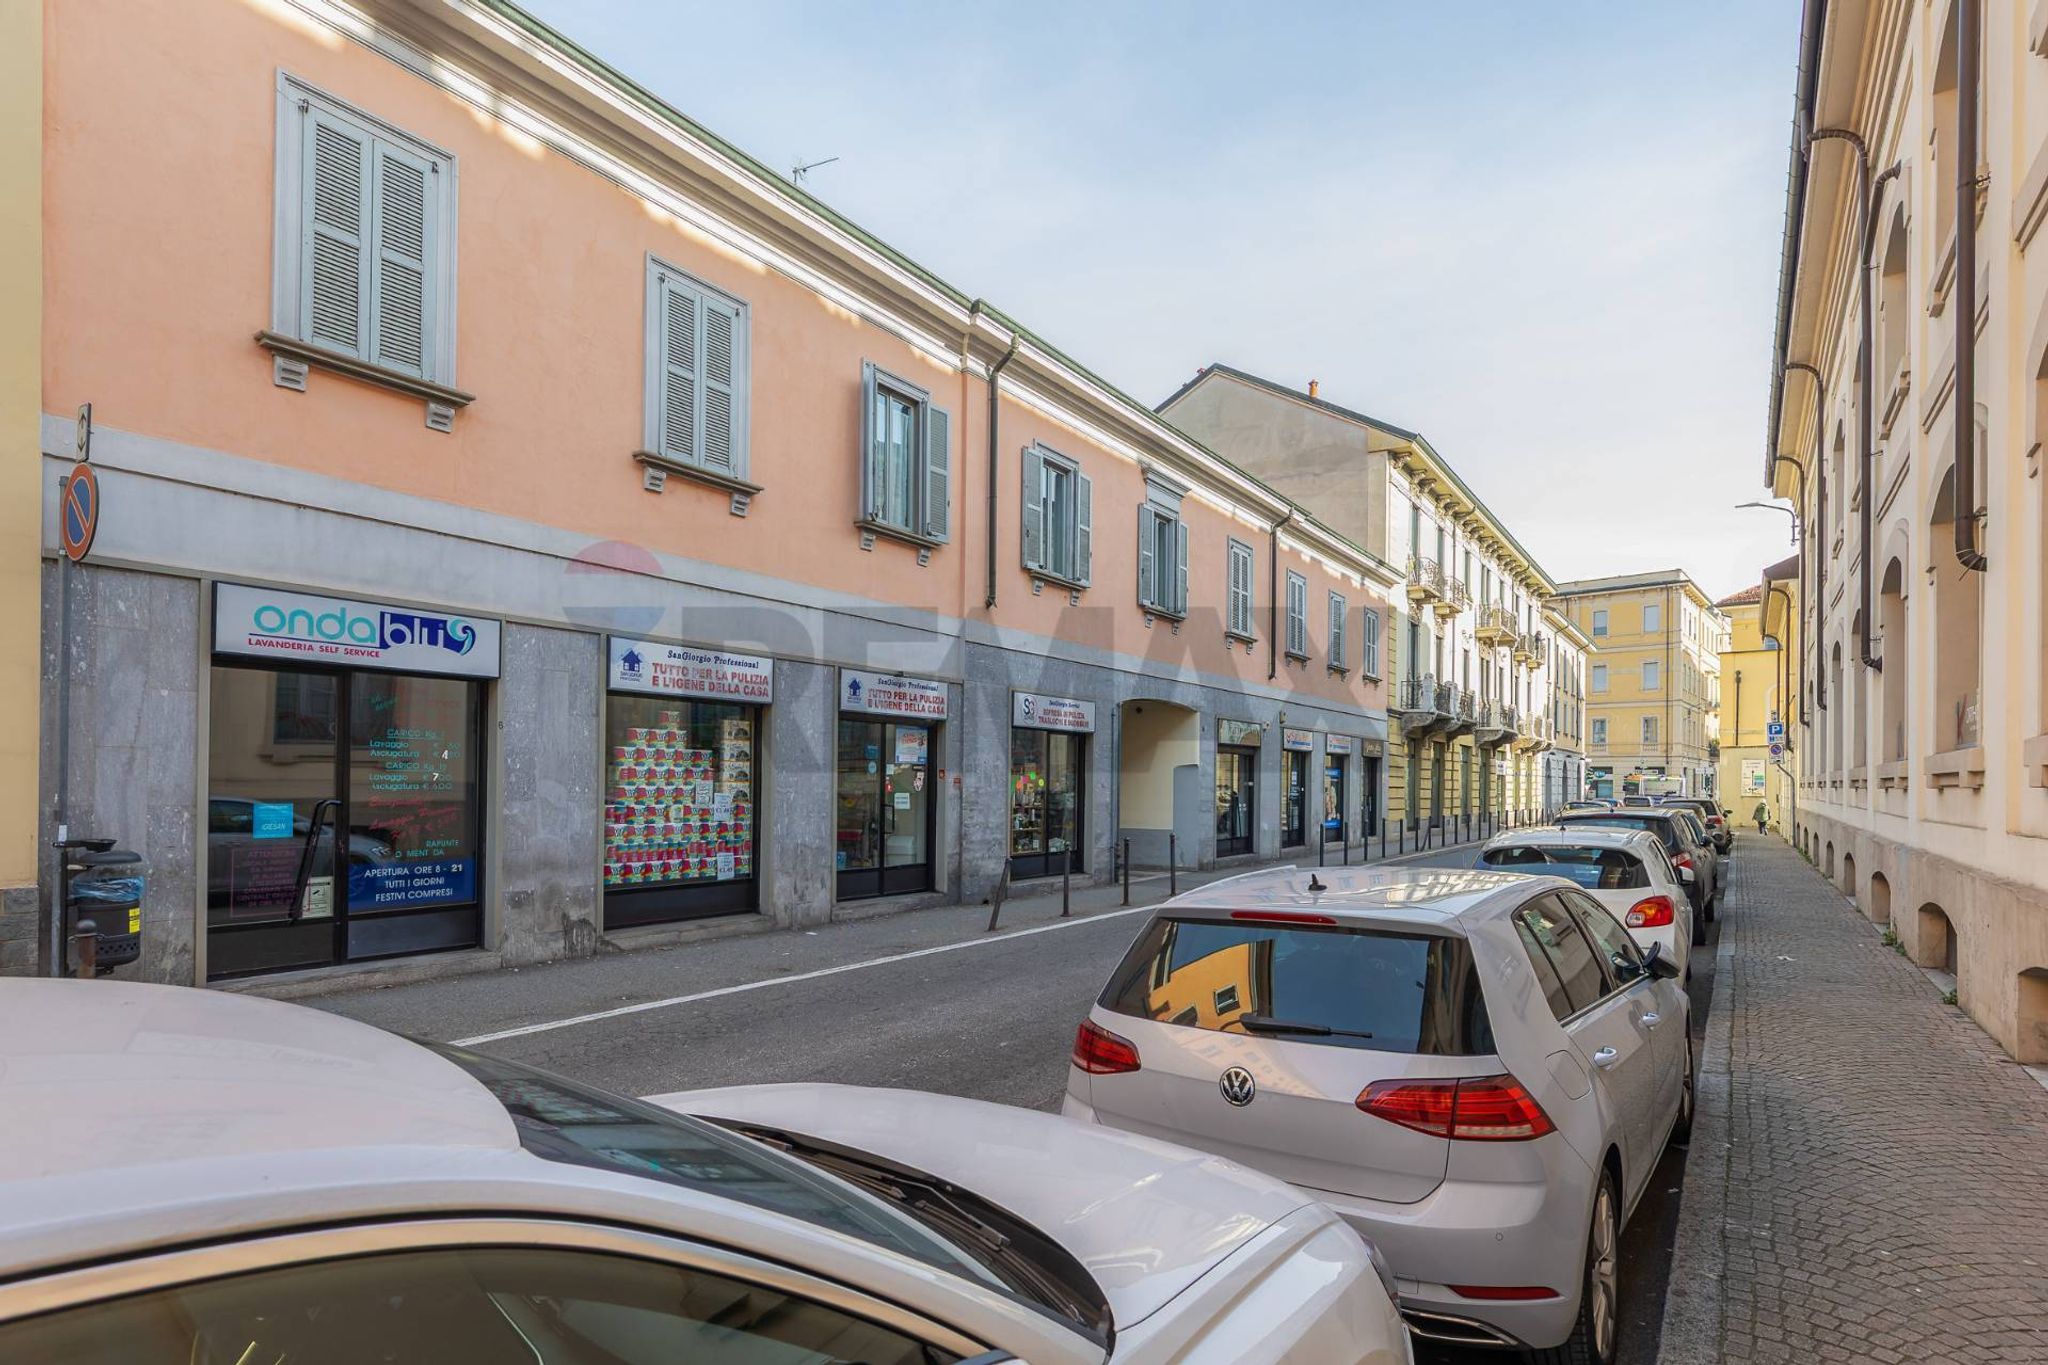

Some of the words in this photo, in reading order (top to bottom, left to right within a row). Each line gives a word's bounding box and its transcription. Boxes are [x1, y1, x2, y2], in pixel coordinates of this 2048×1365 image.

[249, 638, 314, 652] LAVANDERIA
[319, 645, 339, 654] SELF
[344, 647, 380, 658] SERVICE
[668, 650, 711, 664] SanGiorgio
[714, 655, 759, 669] Professional
[652, 662, 688, 676] TUTTO
[691, 666, 713, 678] PER
[715, 669, 728, 681] LA
[732, 671, 769, 686] PULIZIA
[652, 676, 659, 687] E
[709, 681, 739, 695] DELLA
[743, 685, 769, 700] CASA
[868, 688, 892, 700] TUTTO
[894, 691, 907, 702] PER
[909, 693, 918, 703] LA
[920, 695, 945, 705] PULIZIA
[868, 699, 873, 708] E
[905, 703, 925, 713] DELLA
[928, 705, 945, 715] CASA
[1771, 726, 1780, 735] P
[364, 867, 410, 878] APERTURA
[414, 866, 432, 875] ORE
[435, 865, 441, 873] 8
[451, 863, 463, 873] 21
[385, 880, 405, 889] TUTTI
[413, 877, 445, 887] GIORNI
[375, 892, 406, 902] FESTIVI
[408, 888, 453, 899] COMPRESI
